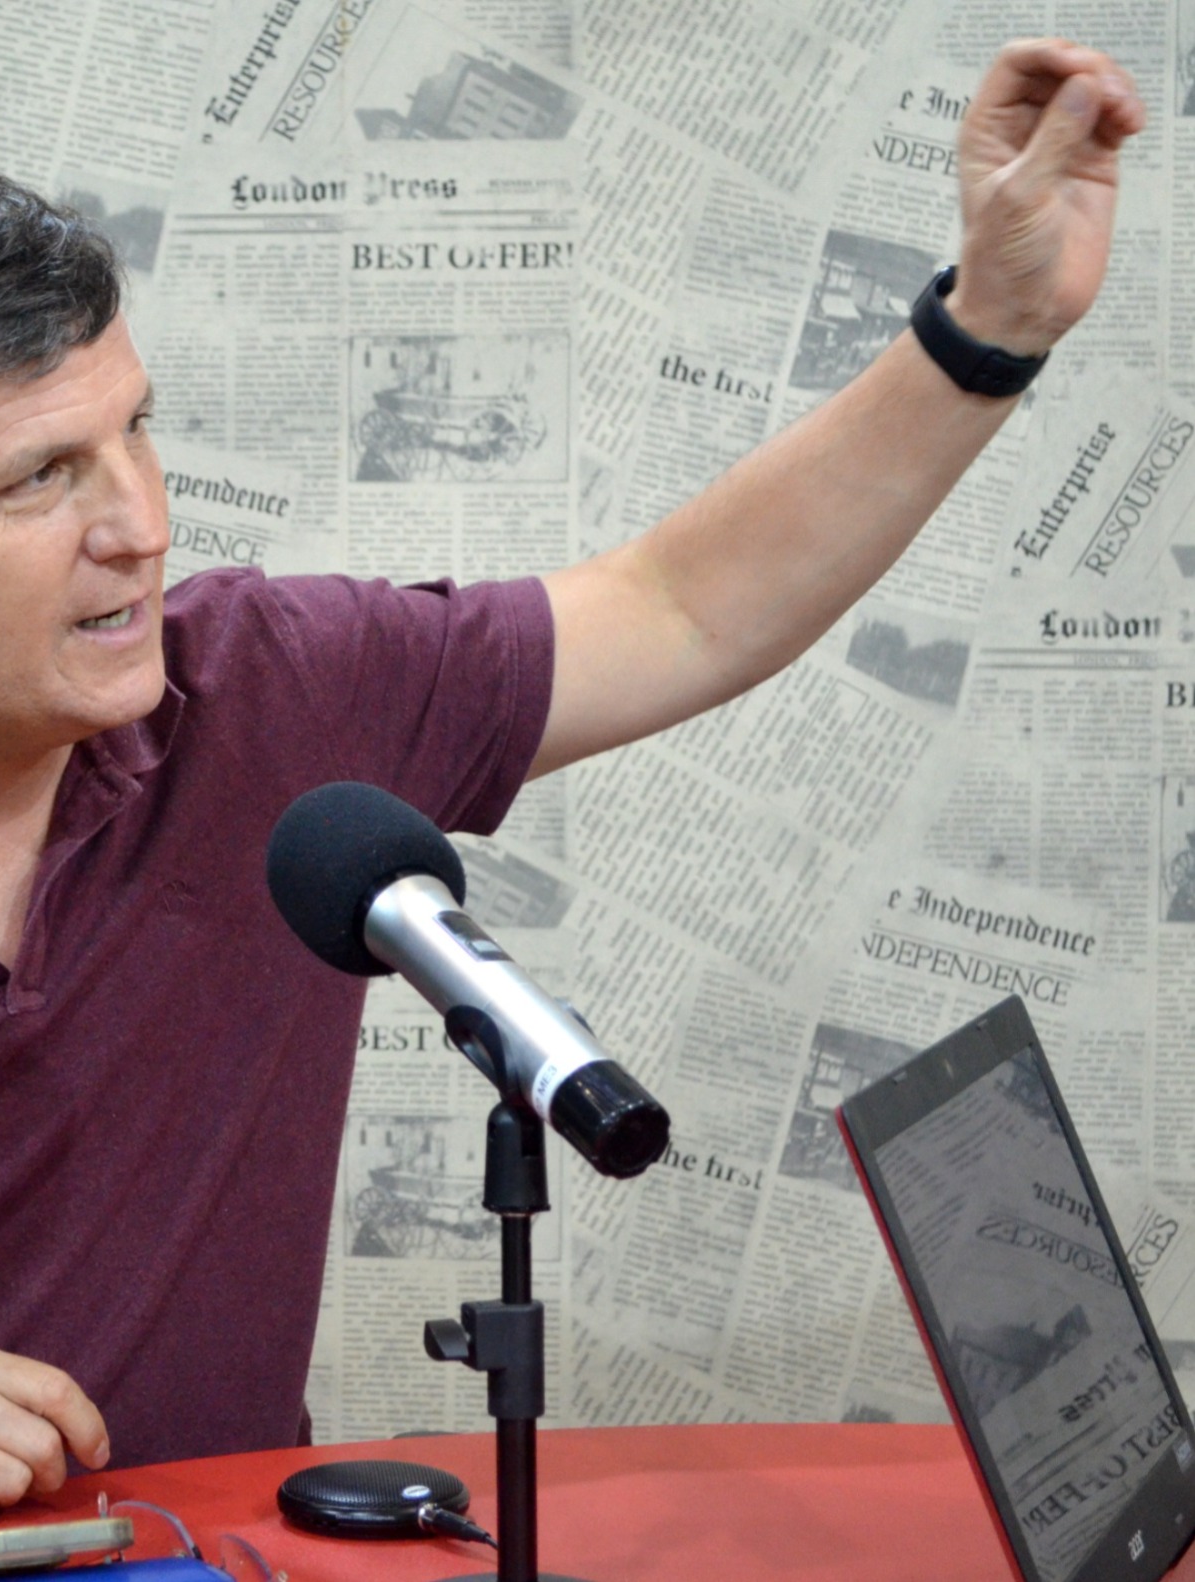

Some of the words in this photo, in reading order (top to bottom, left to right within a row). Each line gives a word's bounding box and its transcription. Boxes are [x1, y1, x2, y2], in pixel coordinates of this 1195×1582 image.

[204, 0, 301, 127] Enterpris
[272, 0, 375, 142] RESOURCE
[230, 174, 347, 210] London
[363, 171, 459, 205] Press
[351, 242, 439, 271] BEST
[449, 241, 575, 270] OFFER!
[659, 353, 707, 387] the
[714, 367, 773, 404] first
[1014, 421, 1117, 561] Enterprise
[1084, 416, 1194, 578] RESOURCES
[169, 520, 268, 566] DENCE
[1040, 609, 1162, 646] London
[910, 885, 1096, 957] Independence
[704, 1152, 764, 1191] first
